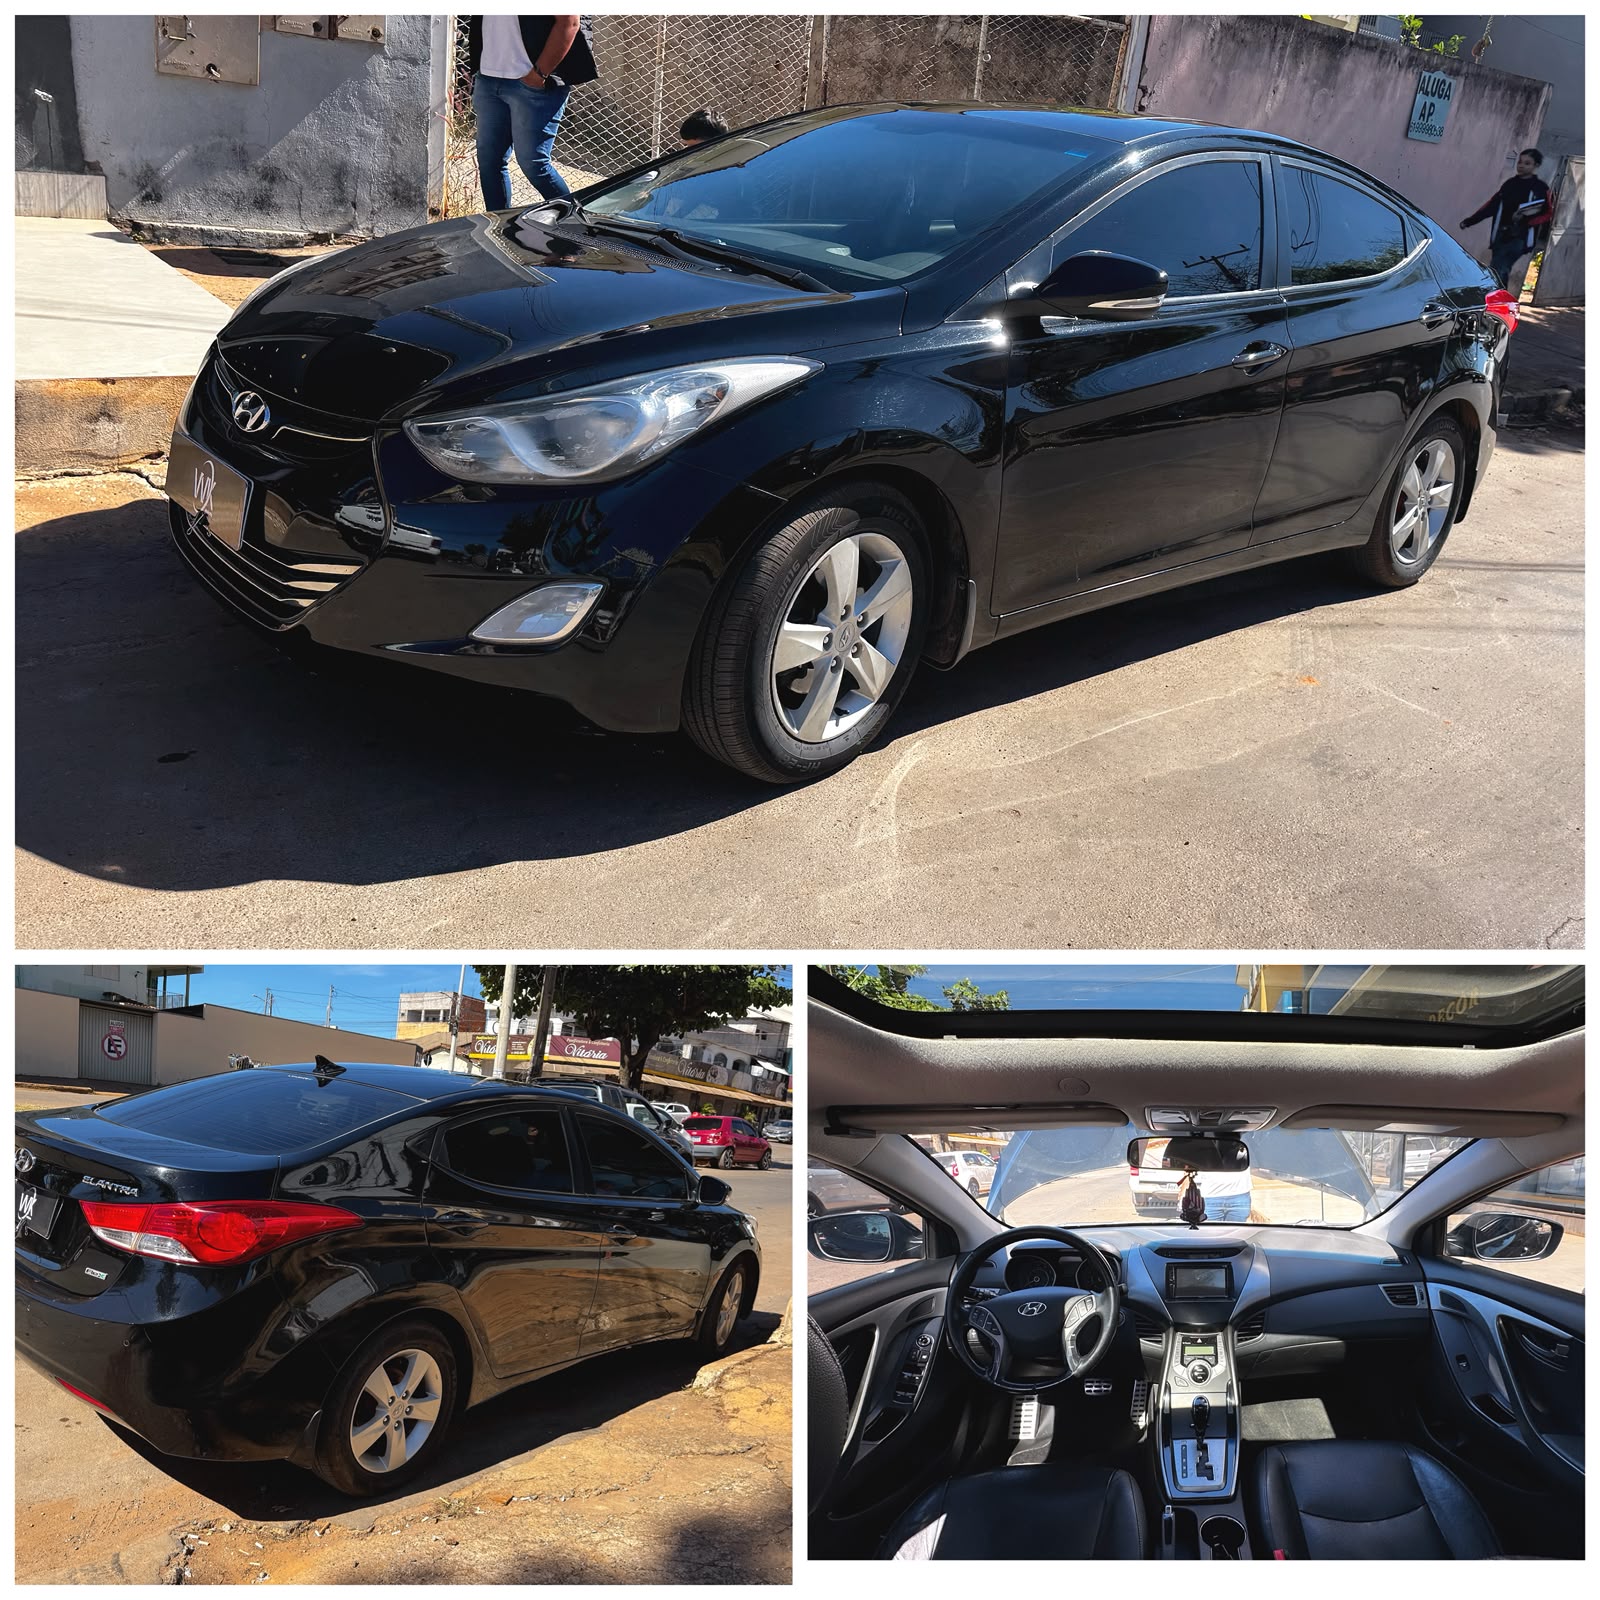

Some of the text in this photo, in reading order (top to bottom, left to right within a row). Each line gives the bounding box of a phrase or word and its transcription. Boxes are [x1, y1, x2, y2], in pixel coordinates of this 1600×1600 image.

[1418, 75, 1452, 101] ALUGA
[564, 1043, 609, 1060] Vitória
[82, 1175, 139, 1197] ELANTRA
